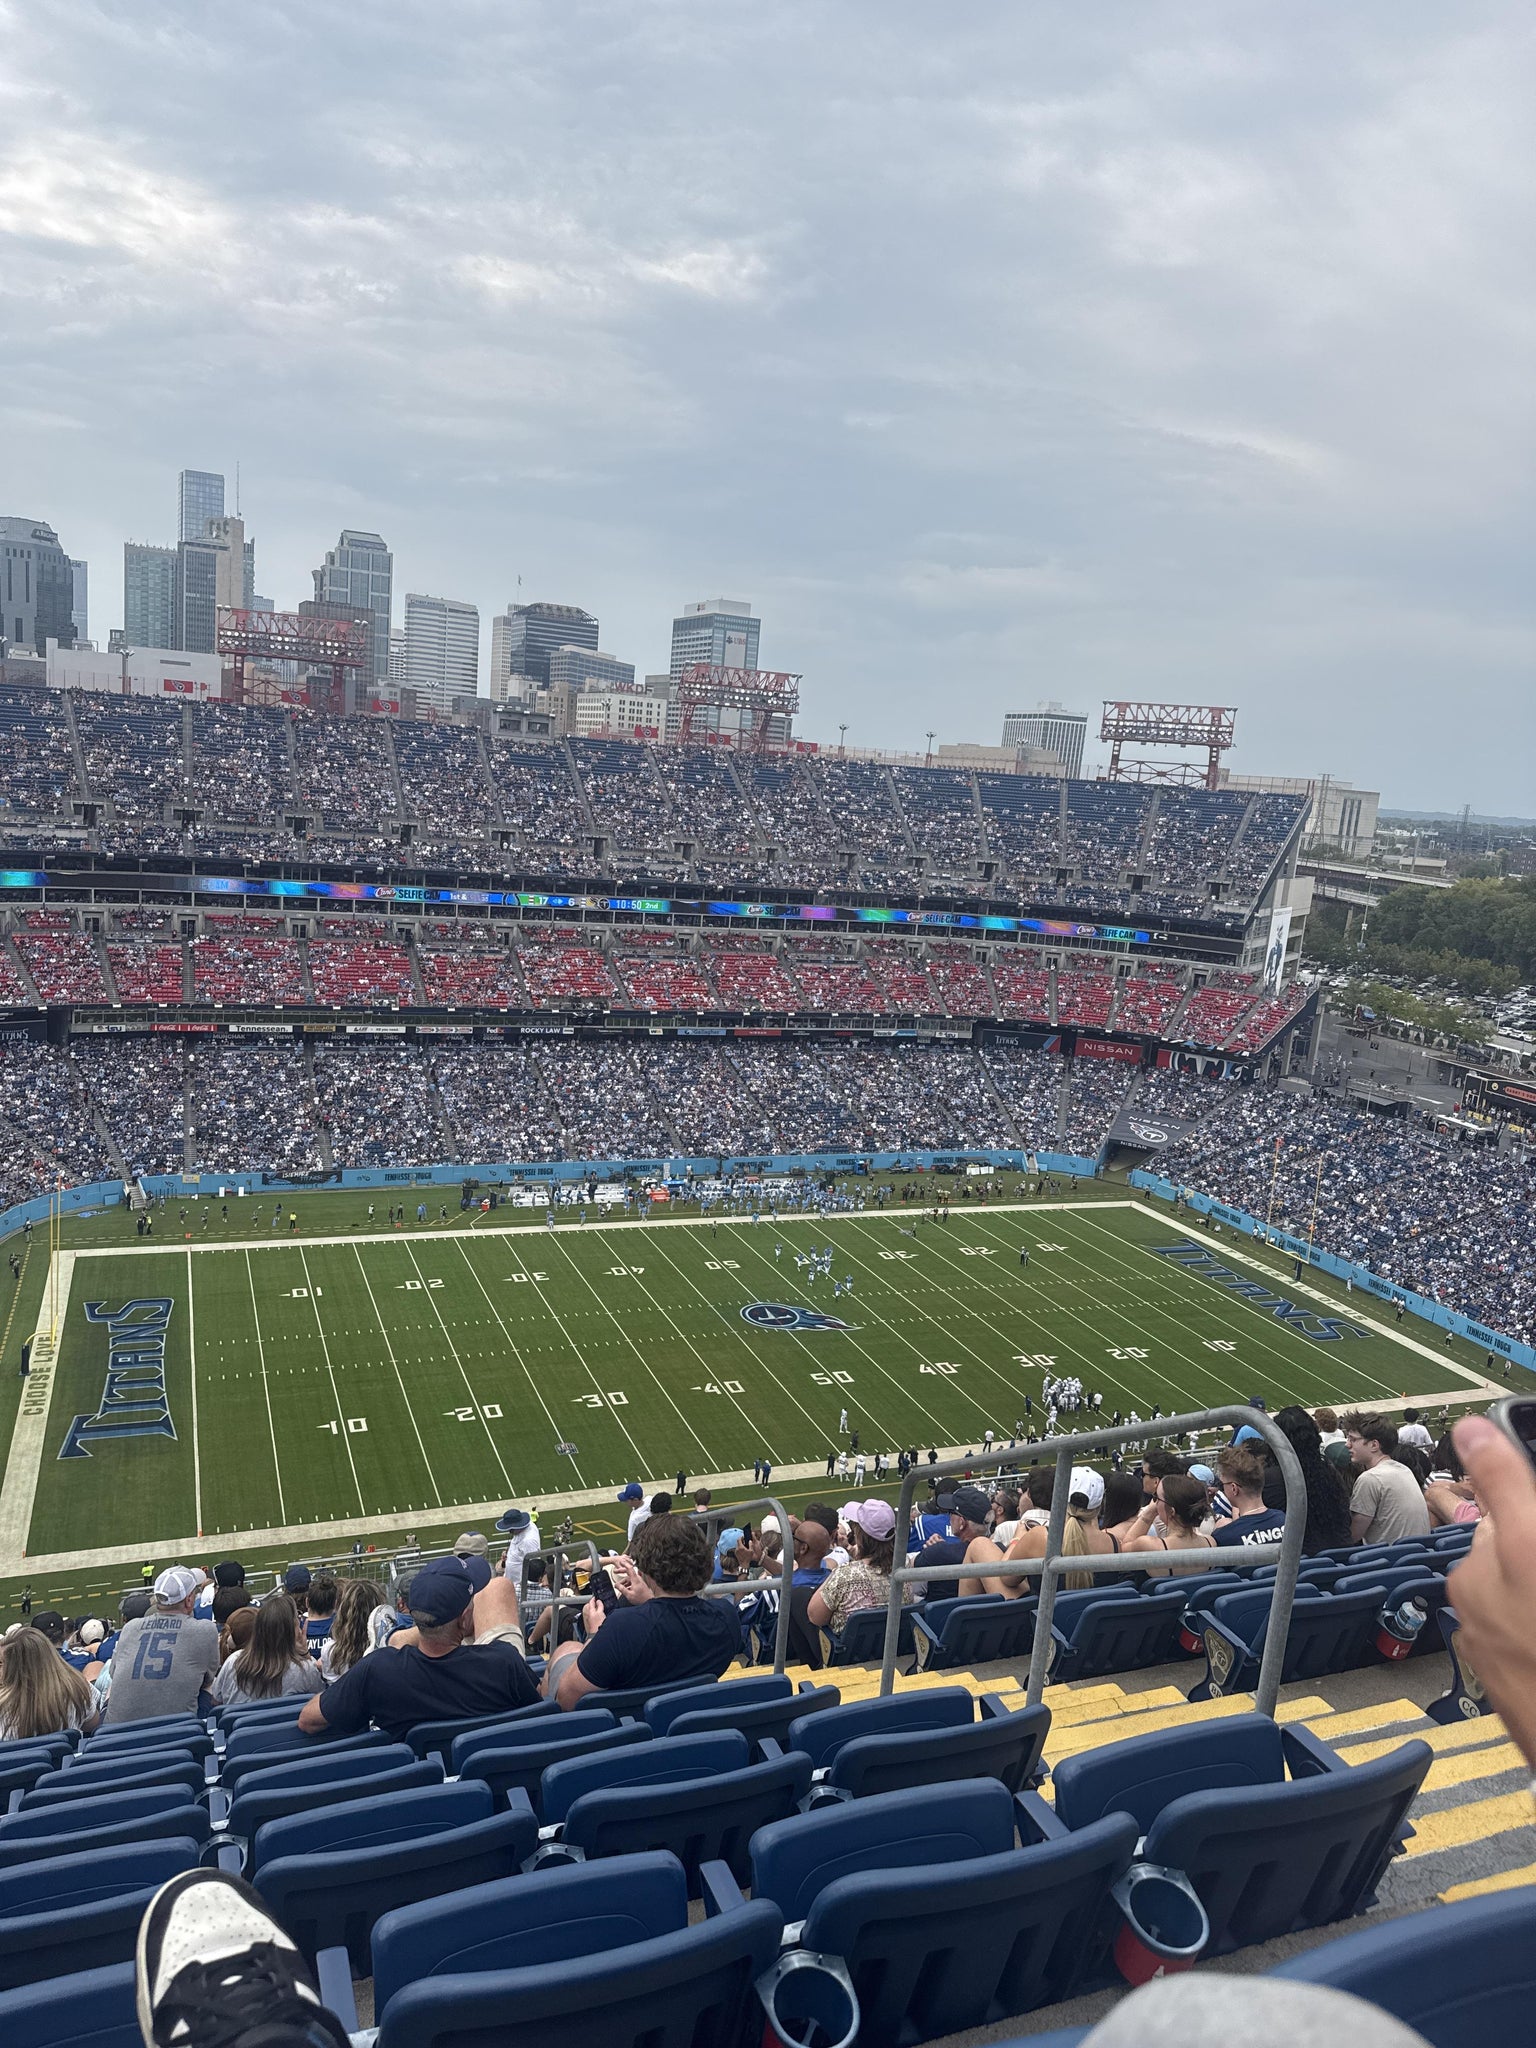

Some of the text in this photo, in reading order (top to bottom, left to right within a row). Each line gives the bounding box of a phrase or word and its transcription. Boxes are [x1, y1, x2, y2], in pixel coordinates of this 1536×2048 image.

[614, 681, 654, 695] WKDF
[398, 889, 422, 900] SELFIE
[450, 892, 460, 901] 1st
[539, 896, 659, 910] 17 6 10:50 2nd
[925, 914, 945, 924] SELFIE
[945, 915, 961, 925] CAM
[1101, 928, 1119, 938] ELFIE
[1119, 930, 1136, 940] CAM
[0, 1028, 29, 1041] ITANS
[994, 1035, 1019, 1046] TITANS
[1083, 1042, 1134, 1056] NISSAN
[1128, 1116, 1181, 1130] NISSAN
[1120, 1141, 1148, 1150] NISSAN
[1149, 1237, 1376, 1342] TITANS
[1367, 1278, 1392, 1296] TENNESSEE
[1317, 1296, 1342, 1307] OF
[1342, 1309, 1369, 1321] US
[1201, 1339, 1237, 1352] 10
[1466, 1324, 1512, 1354] TENNESSEE TOUGH
[1012, 1353, 1056, 1368] 30
[1105, 1346, 1150, 1360] 20
[918, 1361, 958, 1376] 40
[57, 1297, 179, 1461] TITANS
[809, 1369, 855, 1386] 50
[22, 1367, 52, 1417] CHOOSE
[704, 1379, 746, 1395] 40
[580, 1391, 630, 1408] 30
[453, 1404, 504, 1422] 20
[329, 1417, 369, 1435] 10
[140, 1618, 183, 1631] LEONARD
[131, 1631, 178, 1680] 15
[1461, 1700, 1478, 1717] CC
